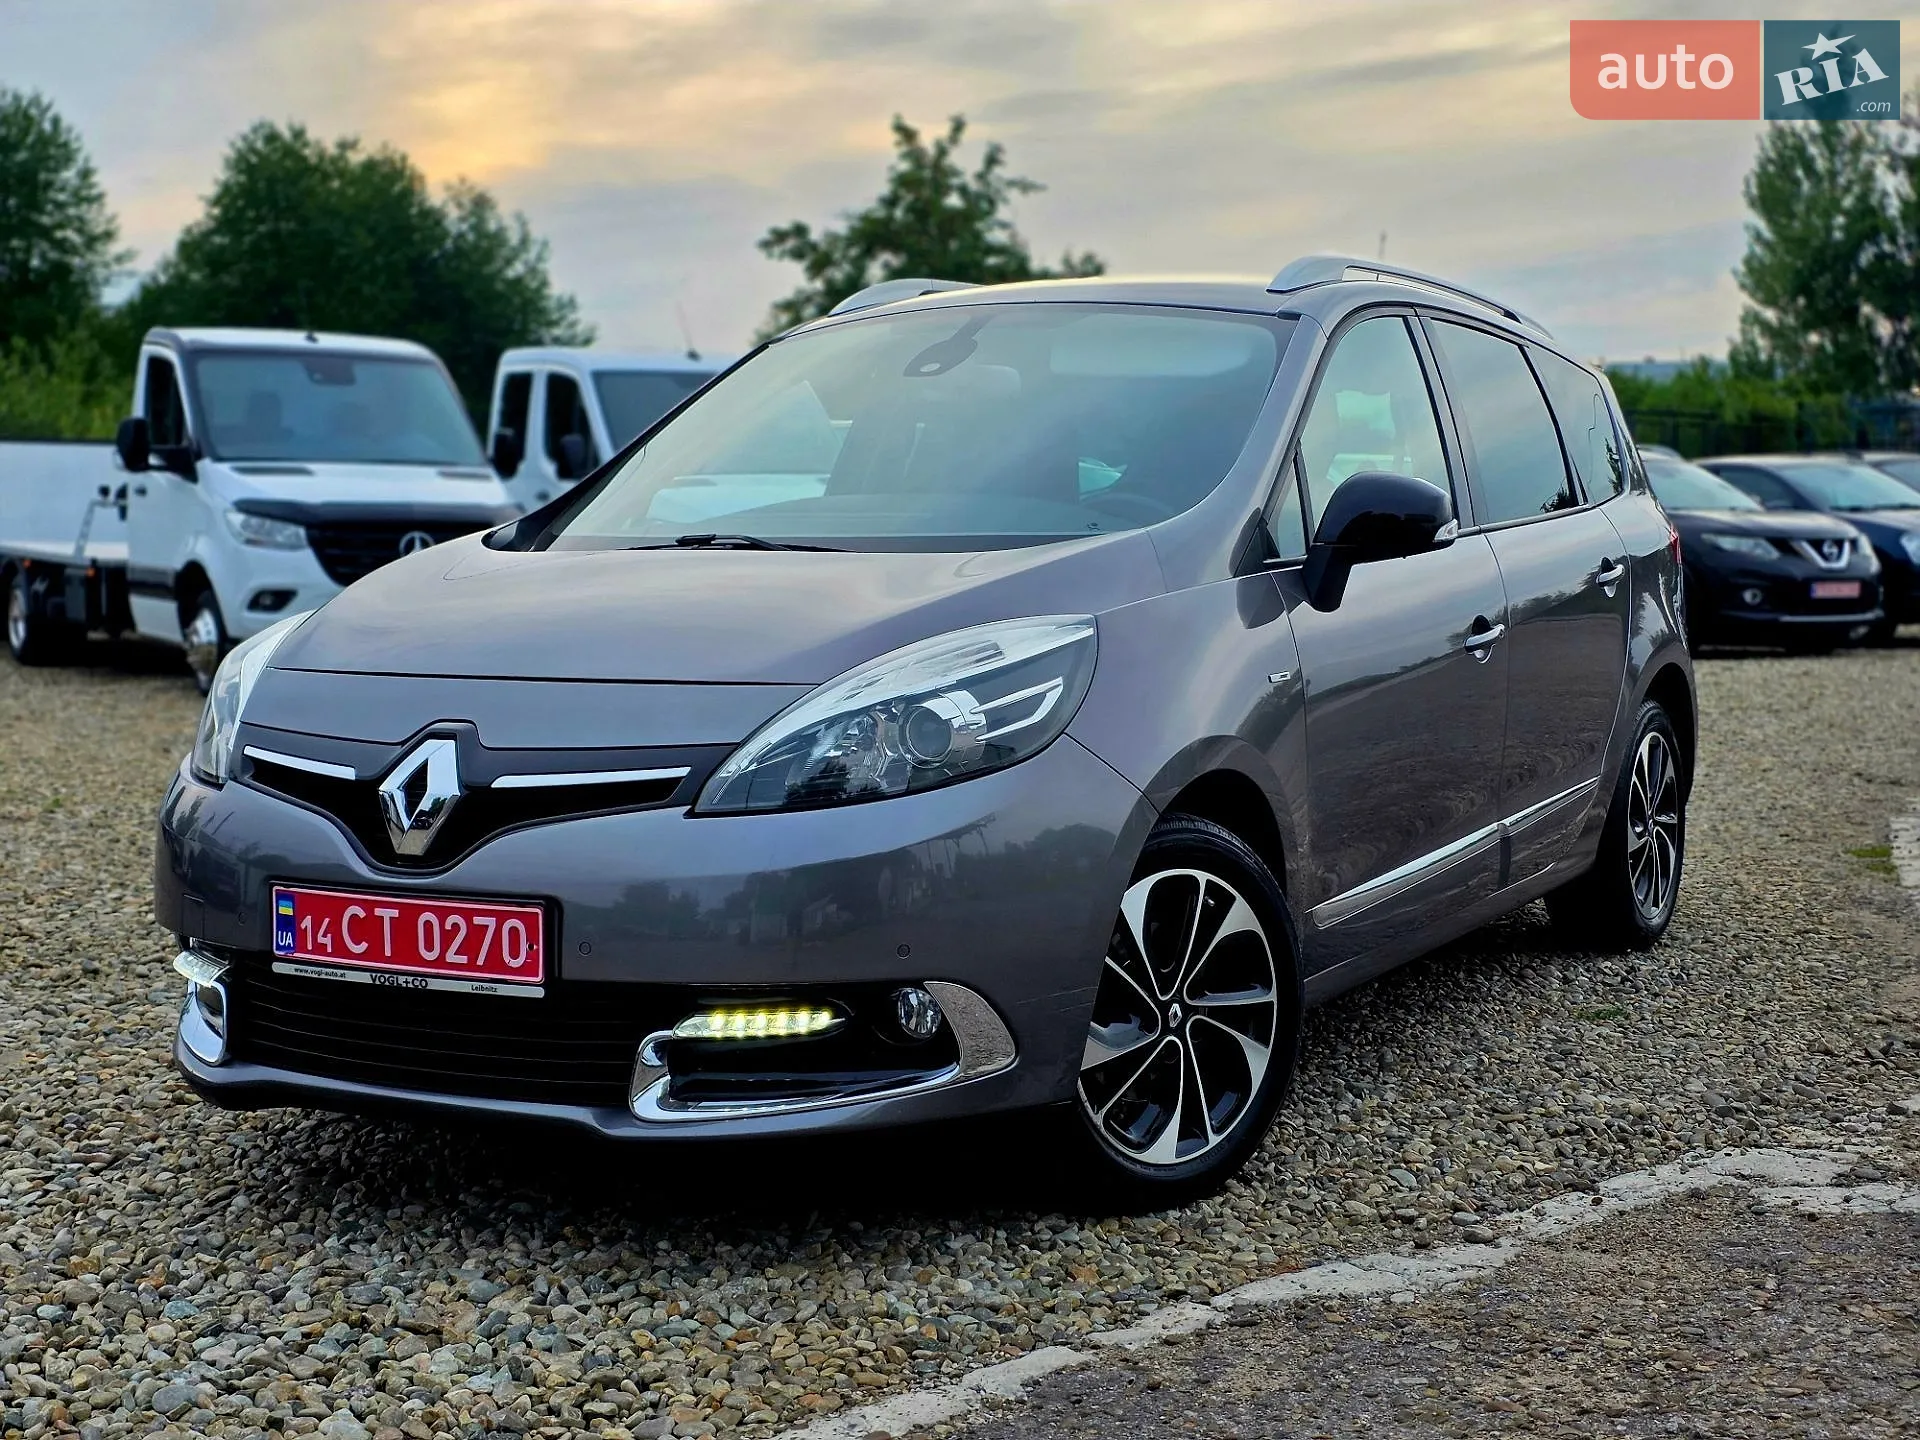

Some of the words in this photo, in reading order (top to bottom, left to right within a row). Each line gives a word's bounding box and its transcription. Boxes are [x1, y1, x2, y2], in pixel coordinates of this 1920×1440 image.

[277, 931, 293, 948] UA
[417, 911, 527, 968] 0270
[294, 967, 346, 979] www.vogl-auto.at
[370, 974, 429, 989] VOGL+CO
[471, 984, 498, 993] Leibnitz
